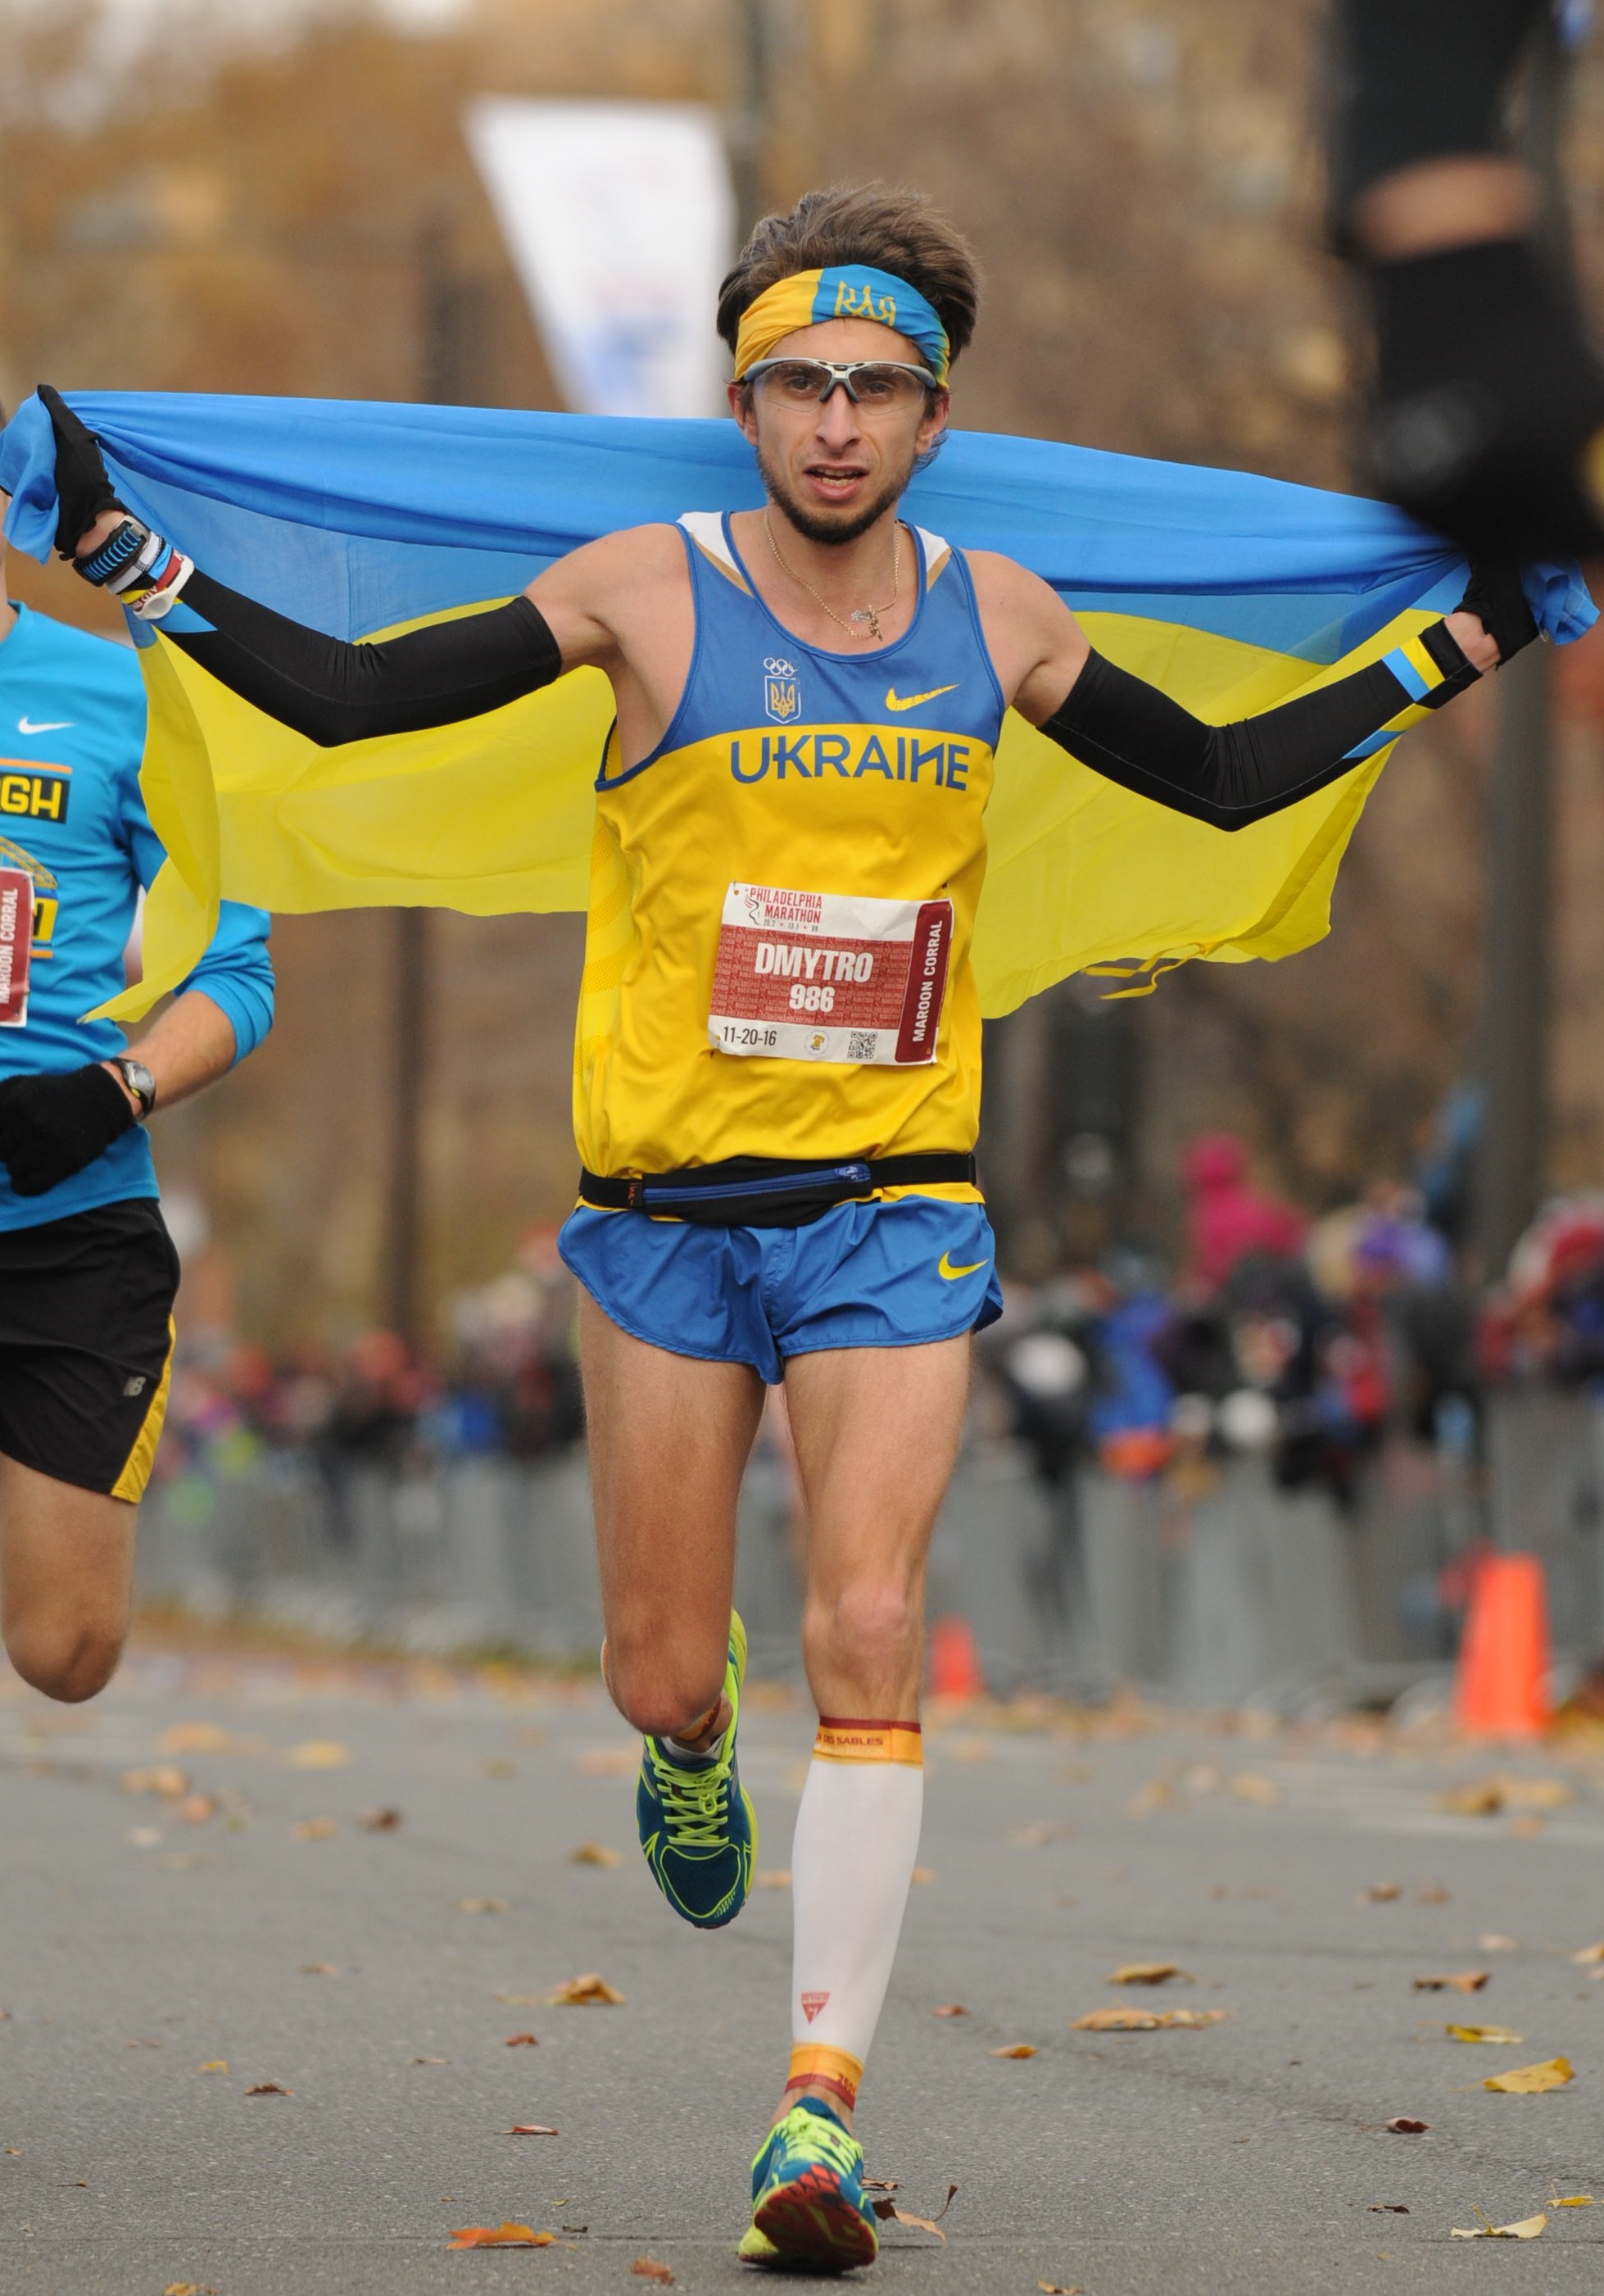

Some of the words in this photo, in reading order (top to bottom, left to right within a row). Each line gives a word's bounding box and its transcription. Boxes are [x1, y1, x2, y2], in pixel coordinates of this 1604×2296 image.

[0, 775, 62, 819] GH
[750, 887, 822, 909] PHILADELPHIA
[0, 888, 18, 942] CORRAL
[764, 905, 821, 923] MARATHON
[754, 943, 873, 982] DMYTRO
[913, 982, 933, 1041] MAROON
[924, 920, 942, 976] CORRAL
[789, 984, 834, 1012] 986
[723, 1026, 777, 1046] 11-20-16
[836, 1736, 883, 1745] SABLES
